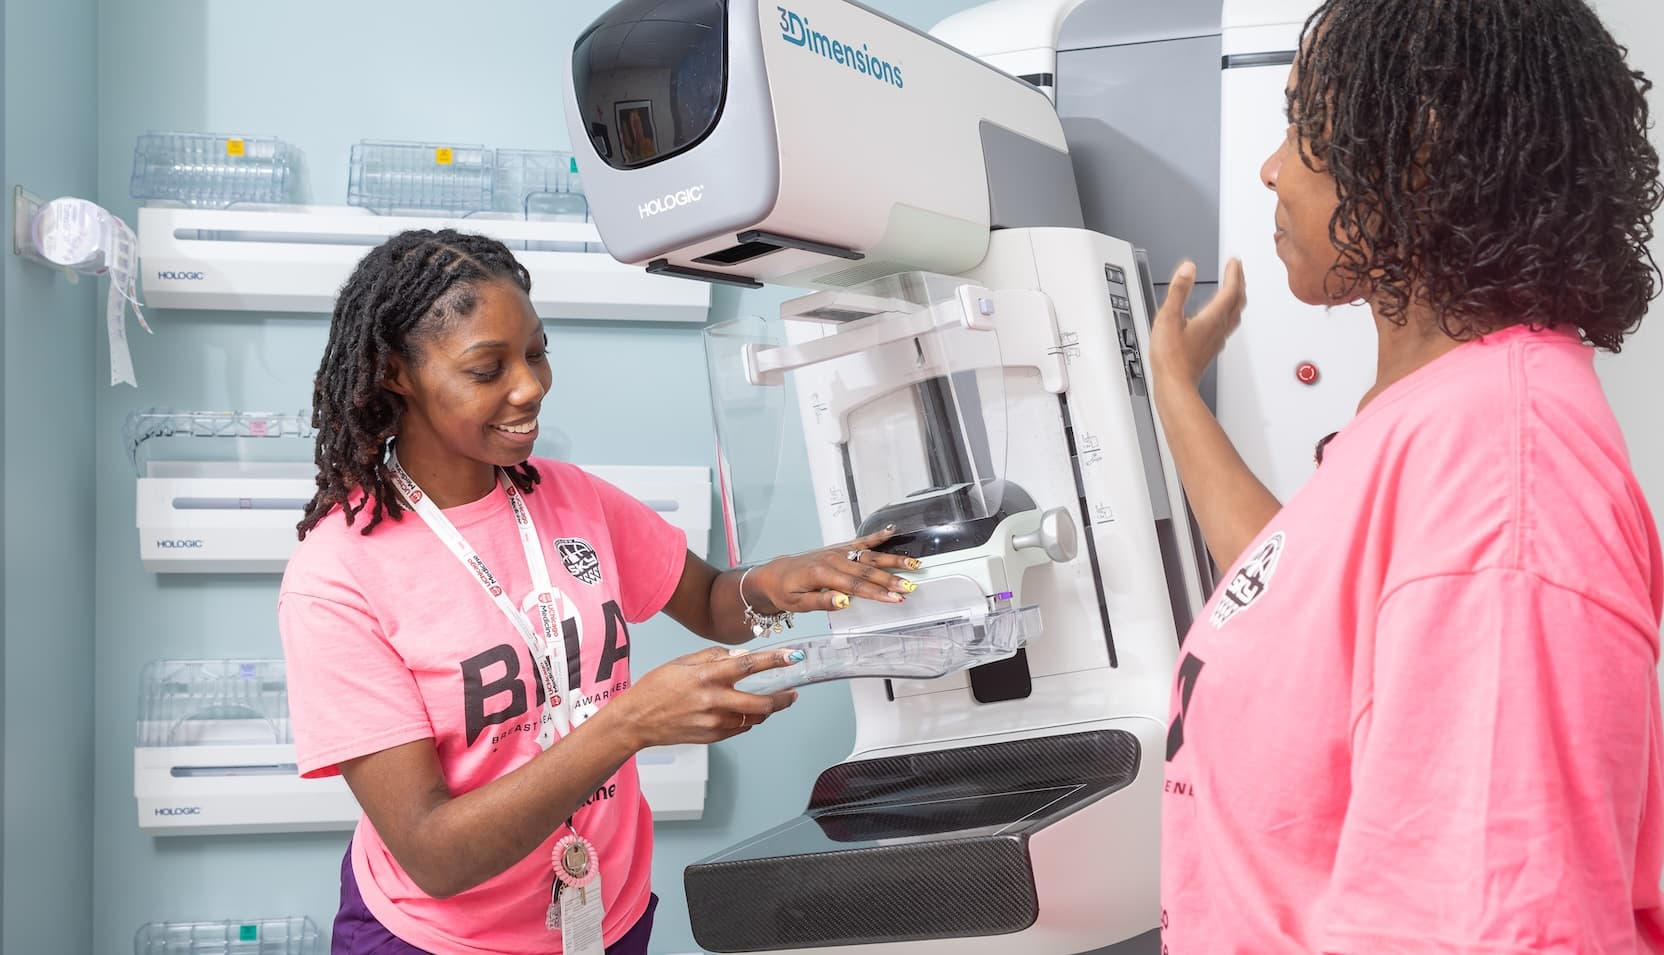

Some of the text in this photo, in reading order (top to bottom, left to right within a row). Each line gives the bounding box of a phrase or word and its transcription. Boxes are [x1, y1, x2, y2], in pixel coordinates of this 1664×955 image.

[777, 6, 903, 89] 3Dimensions
[638, 185, 703, 219] HOLOGIC
[158, 271, 204, 280] HOLOGIC
[157, 540, 203, 549] HOLOGIC
[540, 605, 552, 638] Medicine
[547, 604, 559, 638] UChicago
[155, 806, 201, 816] HOLOGIC
